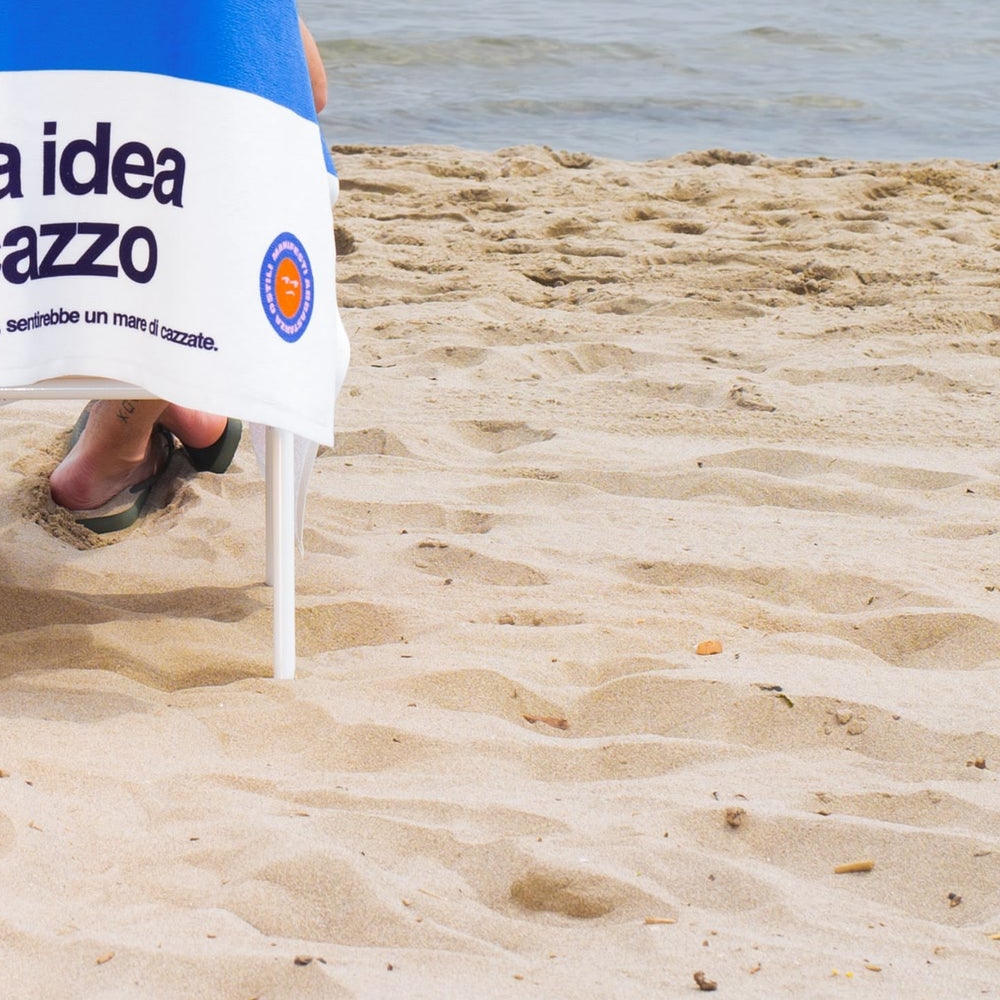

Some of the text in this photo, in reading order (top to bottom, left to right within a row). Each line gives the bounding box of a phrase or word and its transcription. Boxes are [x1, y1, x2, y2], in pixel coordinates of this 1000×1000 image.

[42, 121, 186, 209] idea
[6, 307, 81, 333] sentirebbe
[84, 310, 109, 325] un
[112, 312, 148, 332] mare
[148, 318, 159, 337] di
[160, 325, 219, 352] cazzate.
